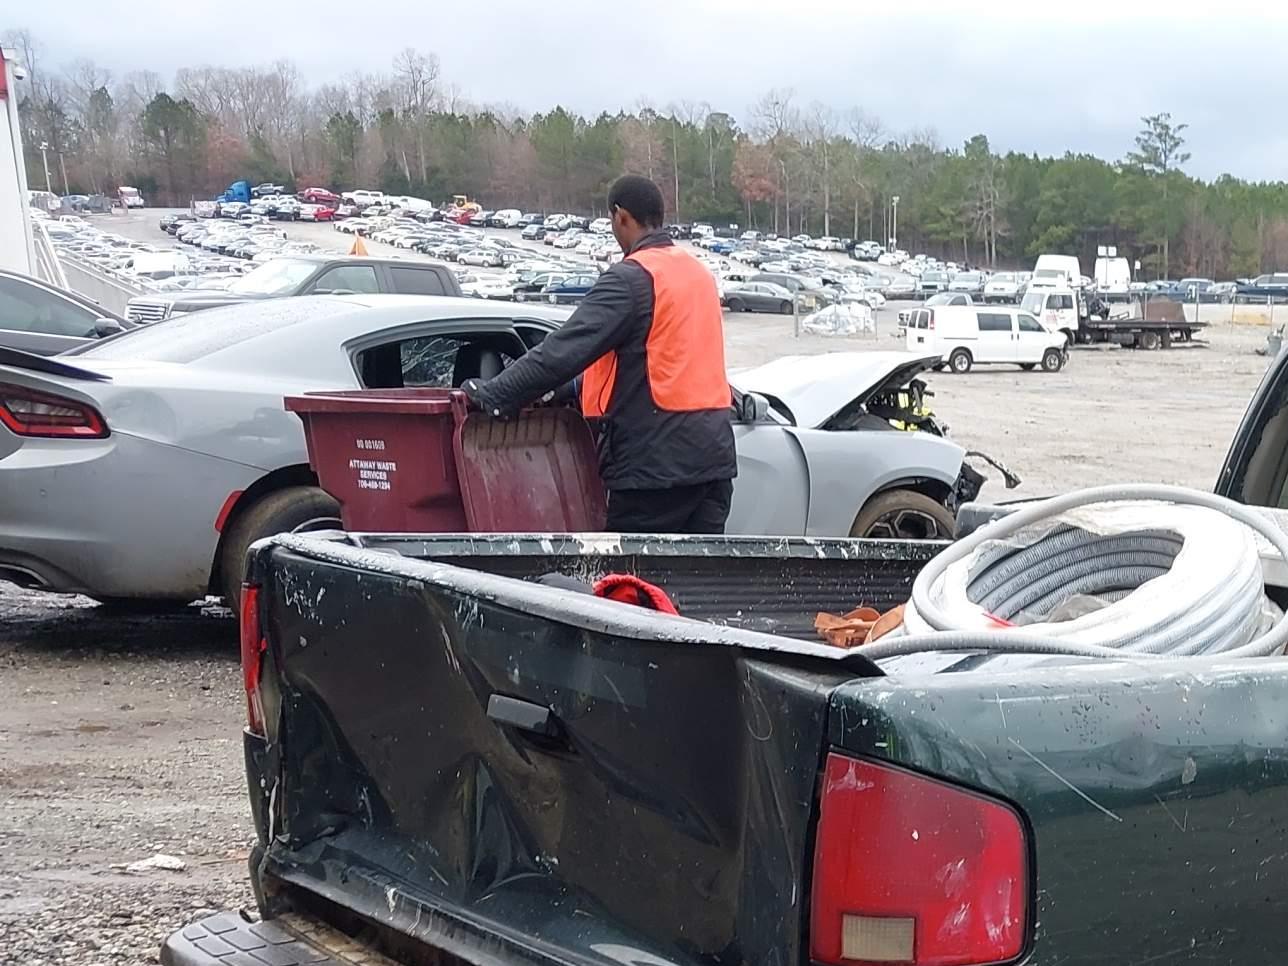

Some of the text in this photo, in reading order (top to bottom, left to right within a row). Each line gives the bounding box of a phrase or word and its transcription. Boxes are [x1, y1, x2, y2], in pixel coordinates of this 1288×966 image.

[349, 459, 397, 472] ATTAWAY WASTE
[360, 470, 387, 480] SERVICES
